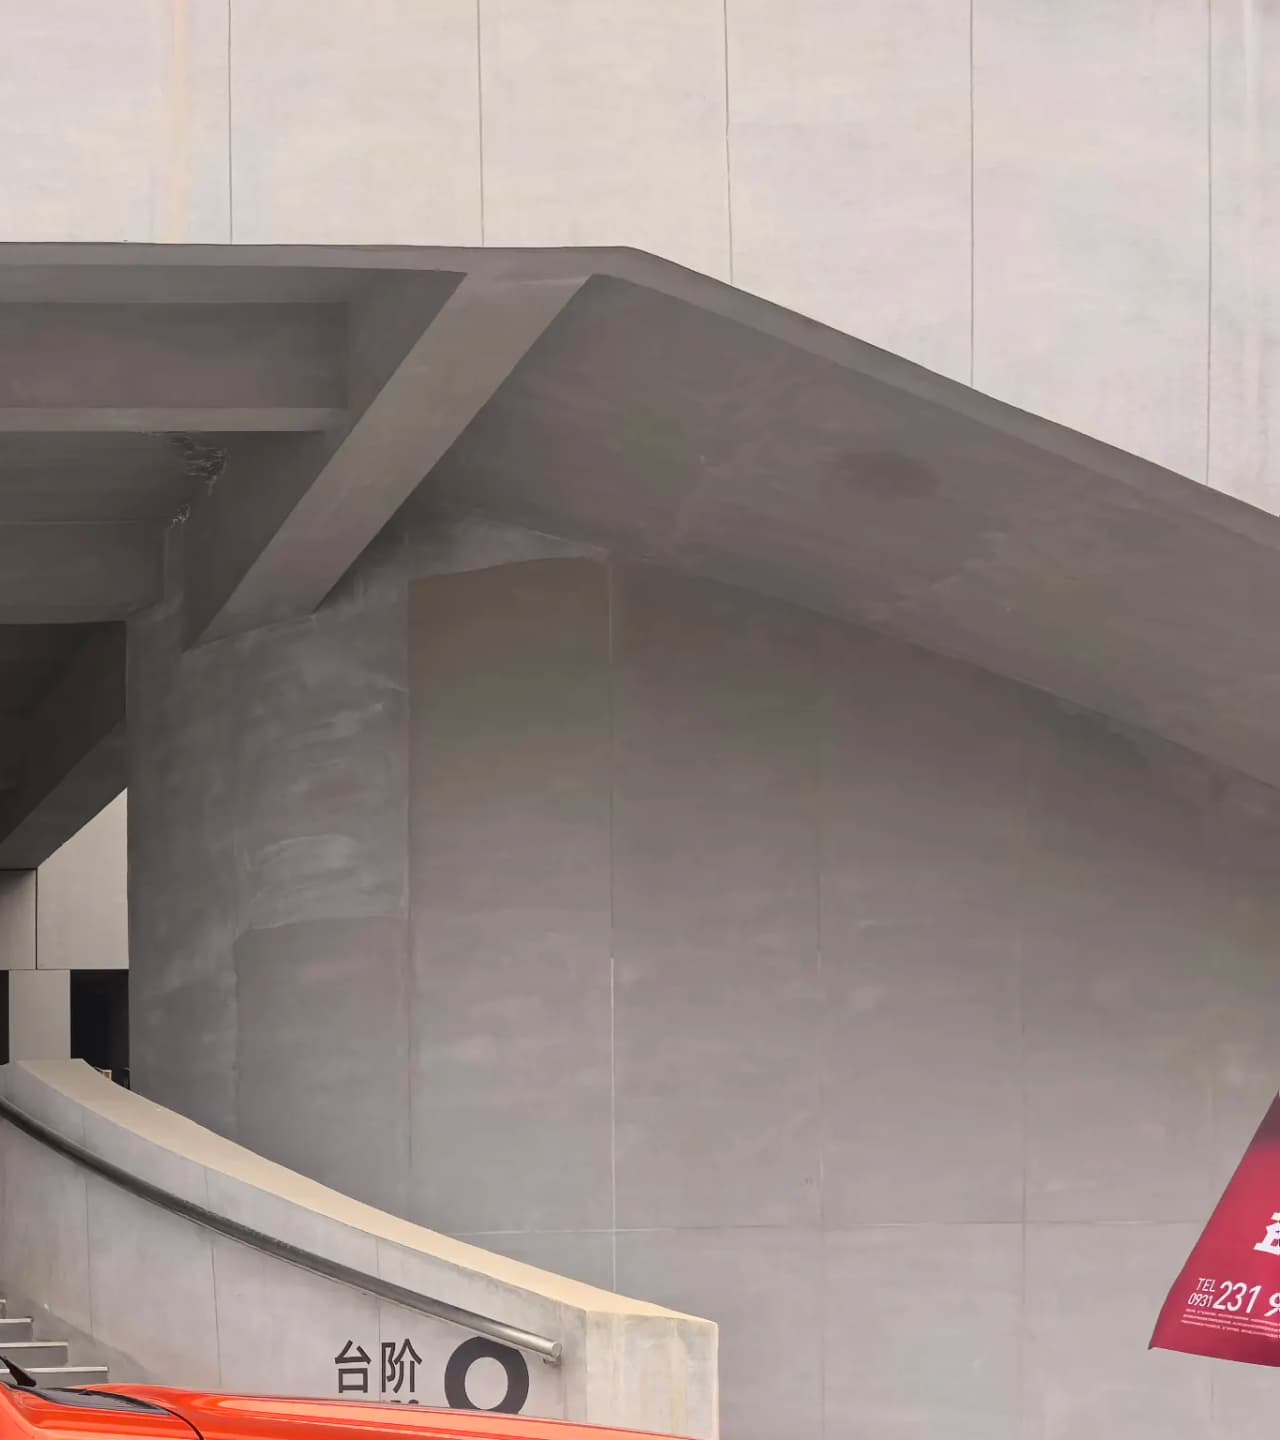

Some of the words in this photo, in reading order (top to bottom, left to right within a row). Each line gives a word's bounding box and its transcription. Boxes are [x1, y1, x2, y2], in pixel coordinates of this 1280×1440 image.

[1195, 1277, 1217, 1293] TEL
[1211, 1280, 1262, 1314] 231
[1187, 1292, 1214, 1308] 0931
[333, 1337, 423, 1394] 台阶
